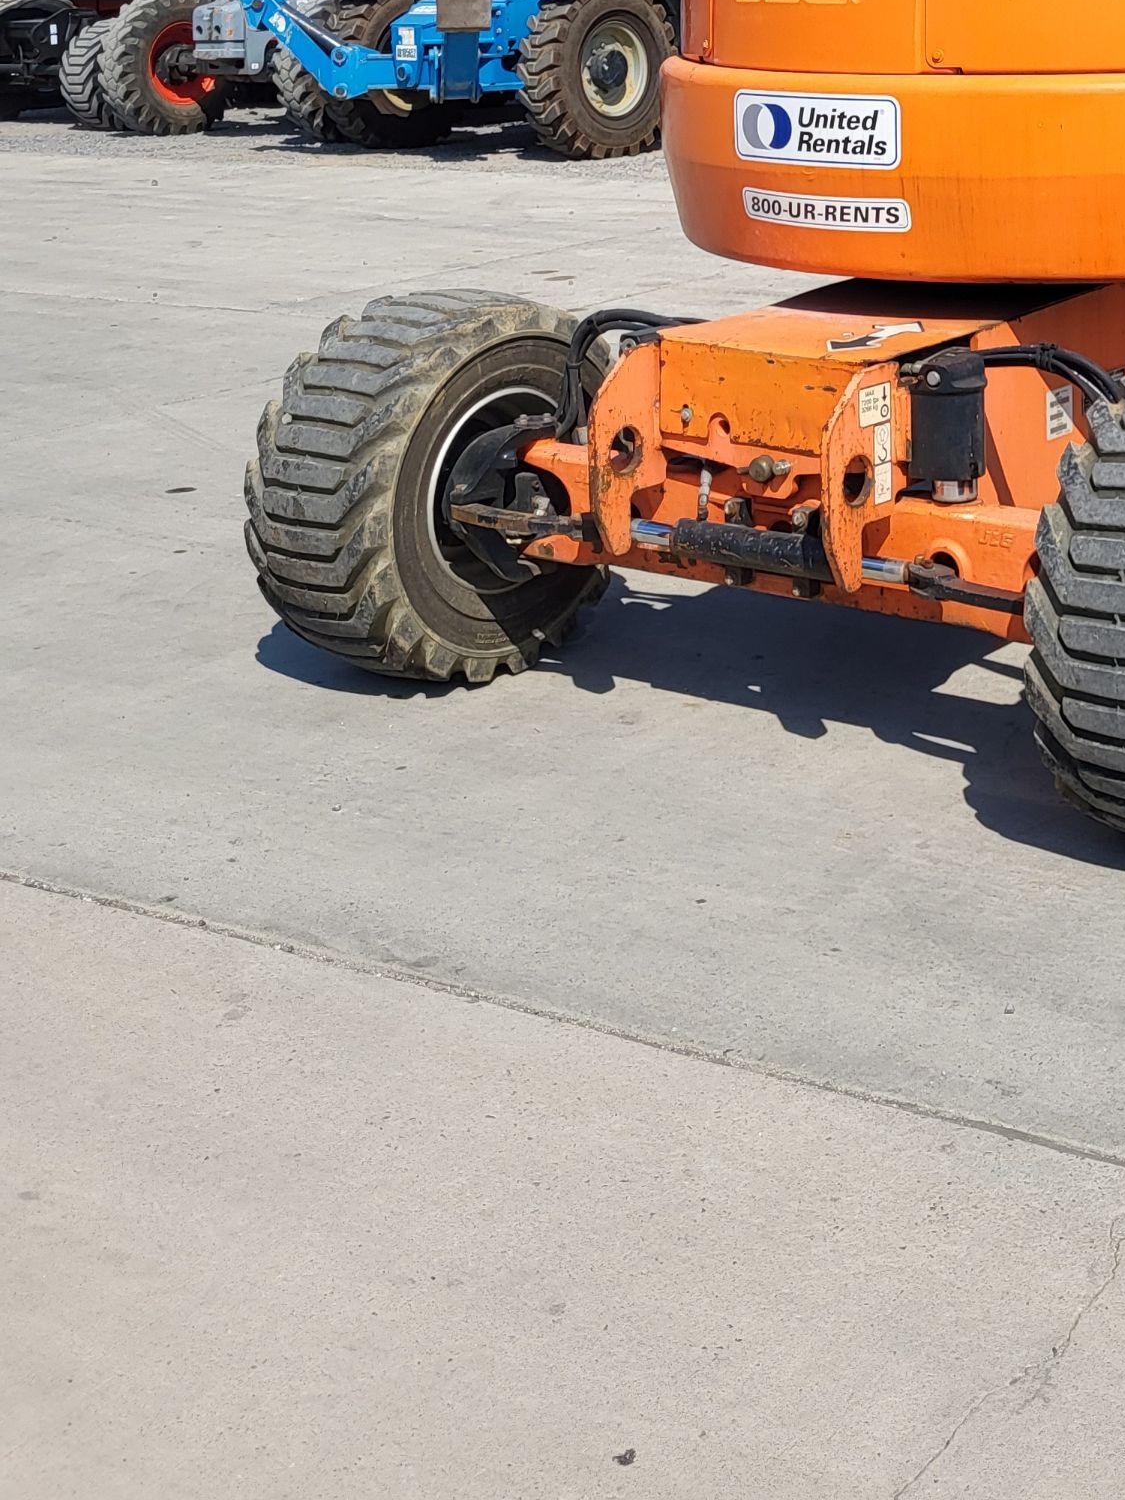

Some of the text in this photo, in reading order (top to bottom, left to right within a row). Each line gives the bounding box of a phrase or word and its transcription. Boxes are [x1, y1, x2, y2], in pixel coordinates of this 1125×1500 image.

[798, 106, 879, 131] United
[797, 131, 888, 156] Rentals
[751, 196, 900, 224] 800-UR-RENTS
